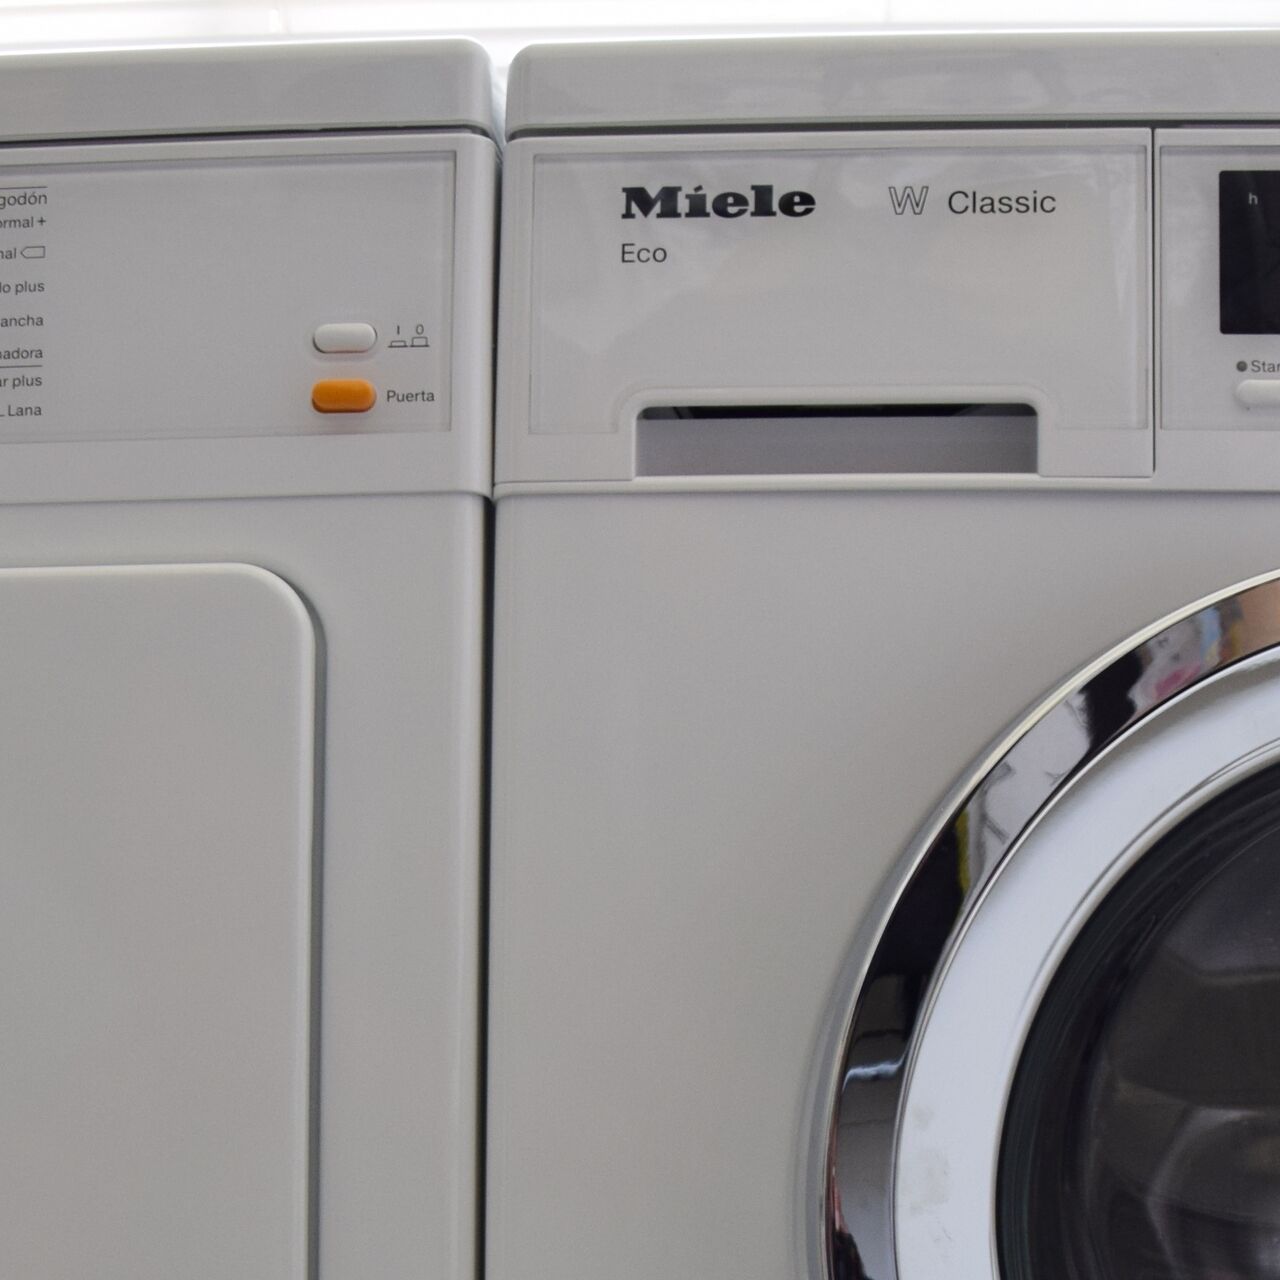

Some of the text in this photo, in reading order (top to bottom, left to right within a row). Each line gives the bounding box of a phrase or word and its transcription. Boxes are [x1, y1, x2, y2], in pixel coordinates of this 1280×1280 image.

[621, 184, 816, 219] Miele
[888, 185, 1057, 216] W Classic
[1249, 193, 1258, 204] h
[621, 242, 668, 264] Eco
[15, 281, 45, 295] plus
[12, 375, 42, 389] plus
[387, 390, 435, 402] Puerta
[7, 405, 42, 417] Lana
